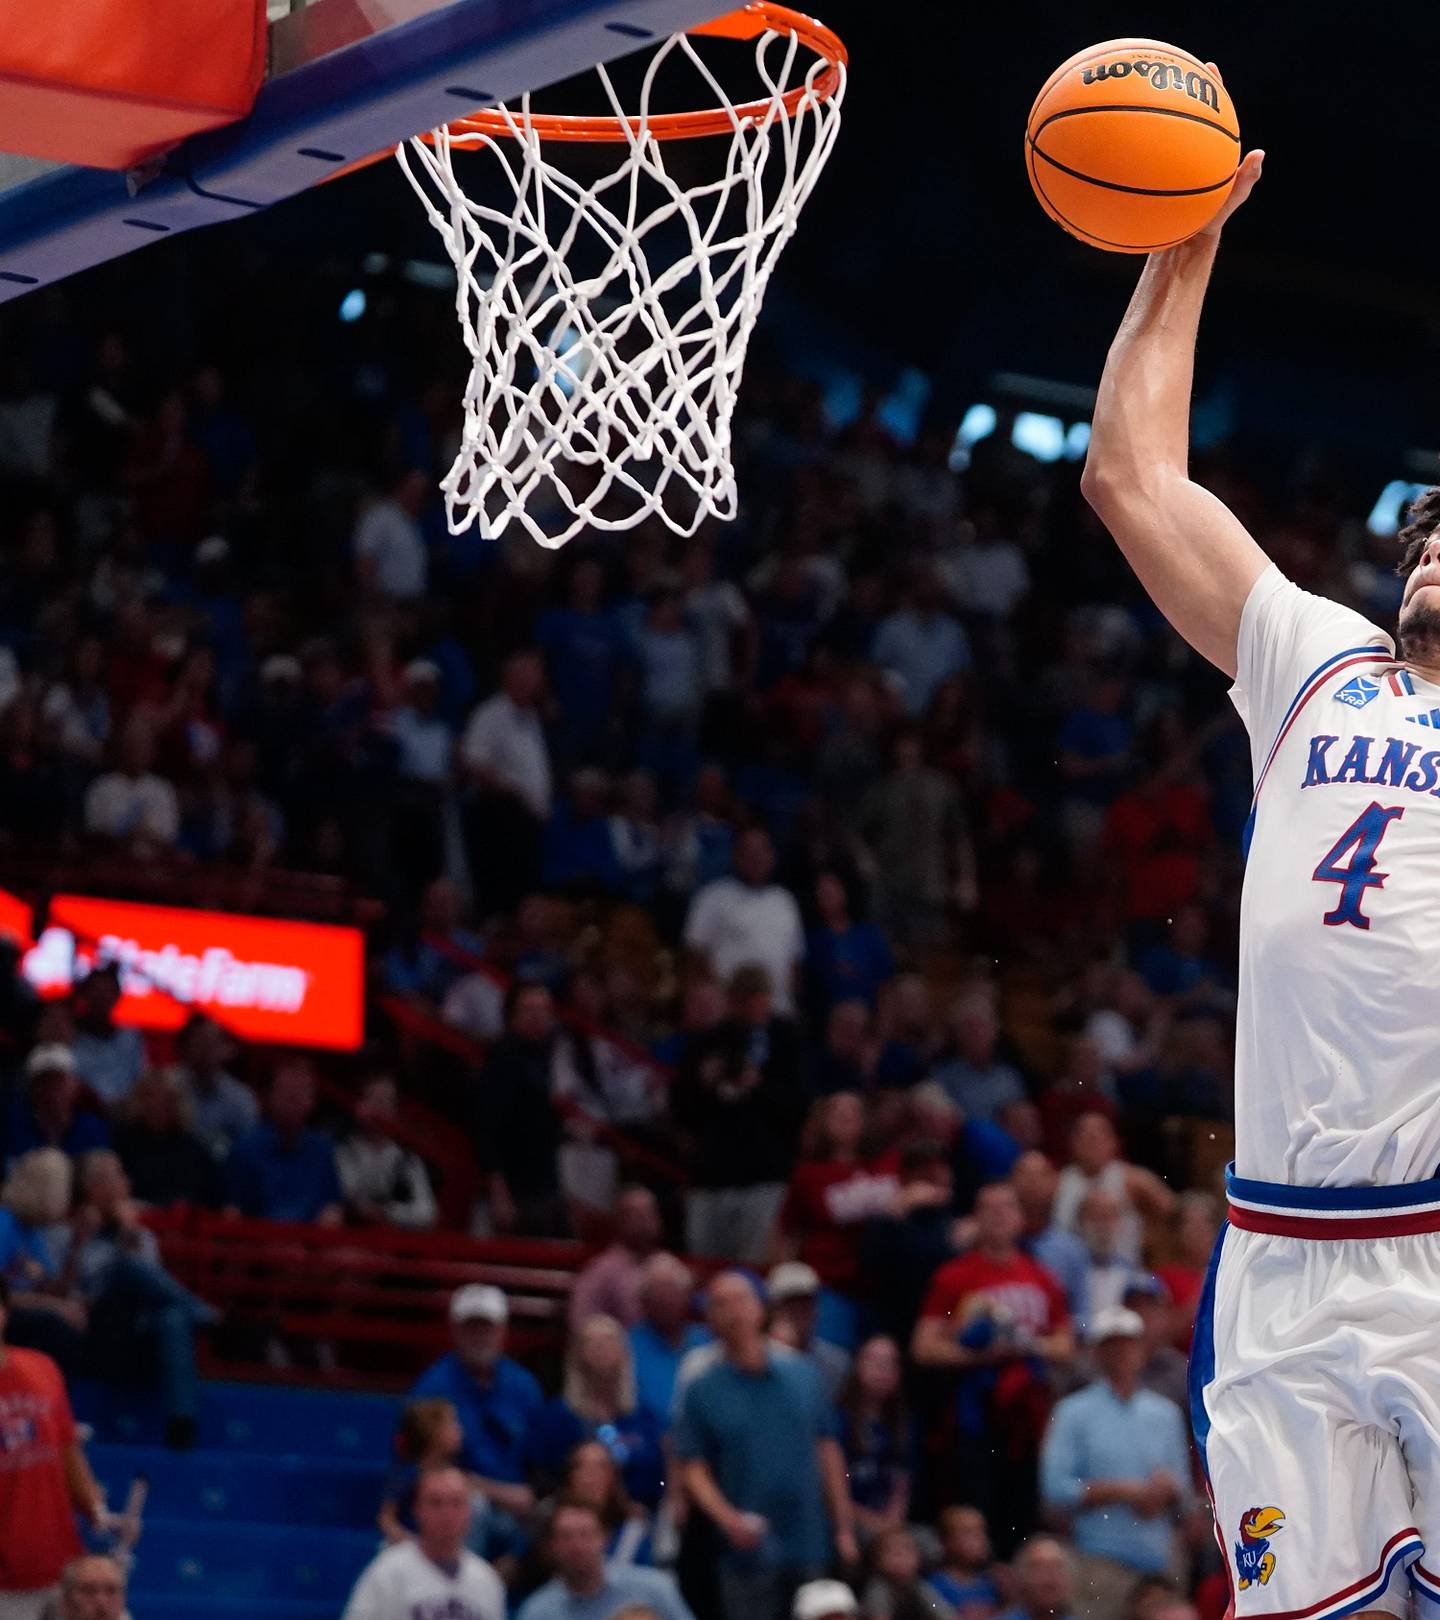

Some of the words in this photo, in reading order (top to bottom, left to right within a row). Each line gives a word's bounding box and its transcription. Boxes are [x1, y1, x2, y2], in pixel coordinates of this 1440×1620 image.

[1081, 60, 1220, 113] Wilson
[1335, 690, 1365, 706] XRP
[1312, 801, 1405, 930] 4
[1242, 1550, 1257, 1567] KU
